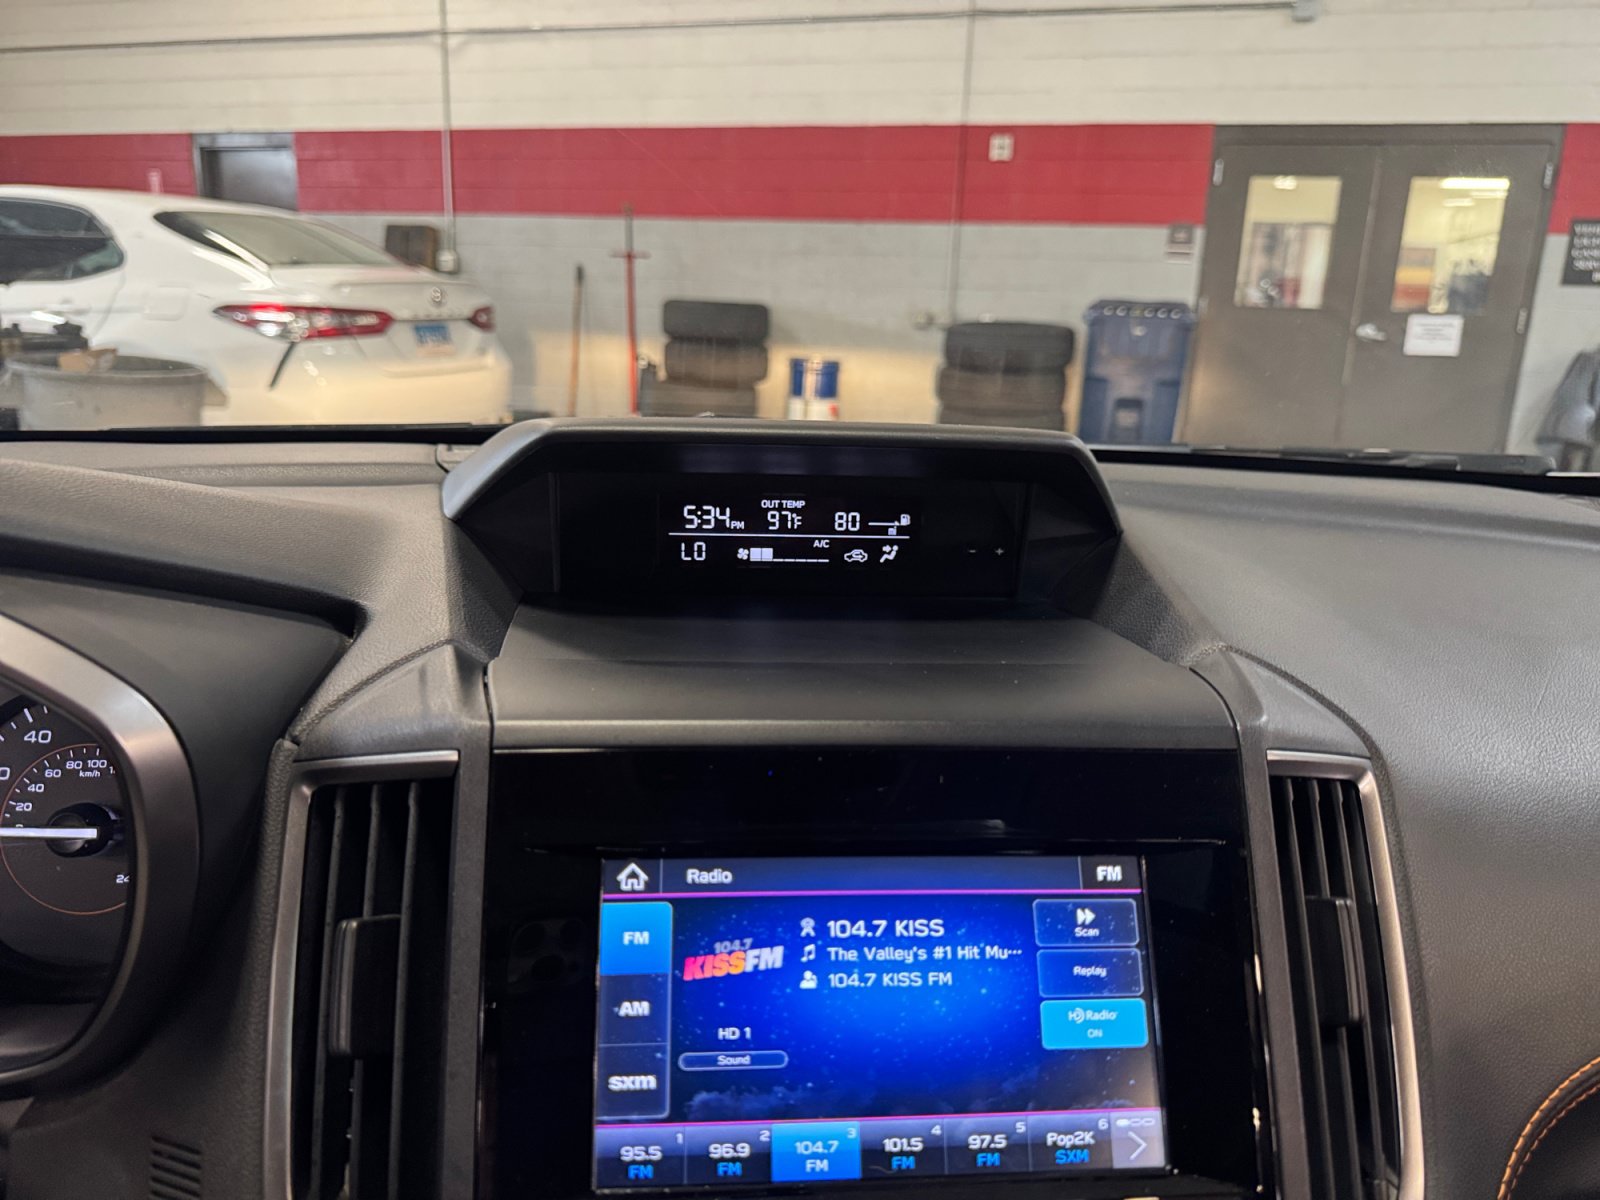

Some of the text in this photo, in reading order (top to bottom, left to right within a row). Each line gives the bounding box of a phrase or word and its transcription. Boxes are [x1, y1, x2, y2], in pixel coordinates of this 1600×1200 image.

[761, 500, 805, 509] OUT TEMP
[683, 505, 745, 530] 5:34 PM
[834, 512, 860, 531] 80
[813, 539, 830, 548] A/C
[681, 542, 706, 561] LO
[23, 730, 52, 743] 40
[66, 760, 83, 769] 80
[87, 759, 107, 768] 100
[44, 769, 61, 778] 60
[79, 770, 101, 778] km/h
[27, 784, 45, 793] 40
[15, 802, 32, 811] 20
[686, 868, 733, 884] Radio
[1096, 865, 1122, 881] FM
[827, 919, 945, 938] 104.7 KISS
[1074, 926, 1099, 937] Scan
[622, 931, 649, 945] FM
[713, 938, 753, 953] 104.7
[826, 947, 858, 962] The
[863, 946, 927, 963] Valley's
[933, 946, 952, 960] #1
[957, 946, 980, 960] Hit
[1073, 965, 1107, 978] Replay
[828, 972, 953, 988] 104.7 KISS FM
[618, 1001, 650, 1017] AM
[717, 1027, 752, 1040] HD 1
[1087, 1028, 1103, 1039] ON
[717, 1054, 751, 1066] Sound
[608, 1074, 657, 1091] sxm
[930, 1124, 942, 1136] 4
[1015, 1122, 1026, 1133] 5
[1098, 1118, 1109, 1130] 6
[675, 1133, 684, 1144] 1
[759, 1130, 770, 1142] 2
[847, 1127, 857, 1139] 3
[1046, 1131, 1096, 1149] Pop2K
[794, 1140, 839, 1155] 104.7
[882, 1137, 924, 1152] 101.5
[967, 1134, 1007, 1149] 97.5
[620, 1145, 662, 1161] 95.5
[708, 1143, 751, 1158] 96.9
[1055, 1149, 1090, 1165] SXM
[805, 1159, 829, 1173] FM
[891, 1156, 916, 1169] FM
[976, 1152, 1000, 1167] FM
[627, 1164, 654, 1179] FM
[717, 1162, 743, 1176] FM
